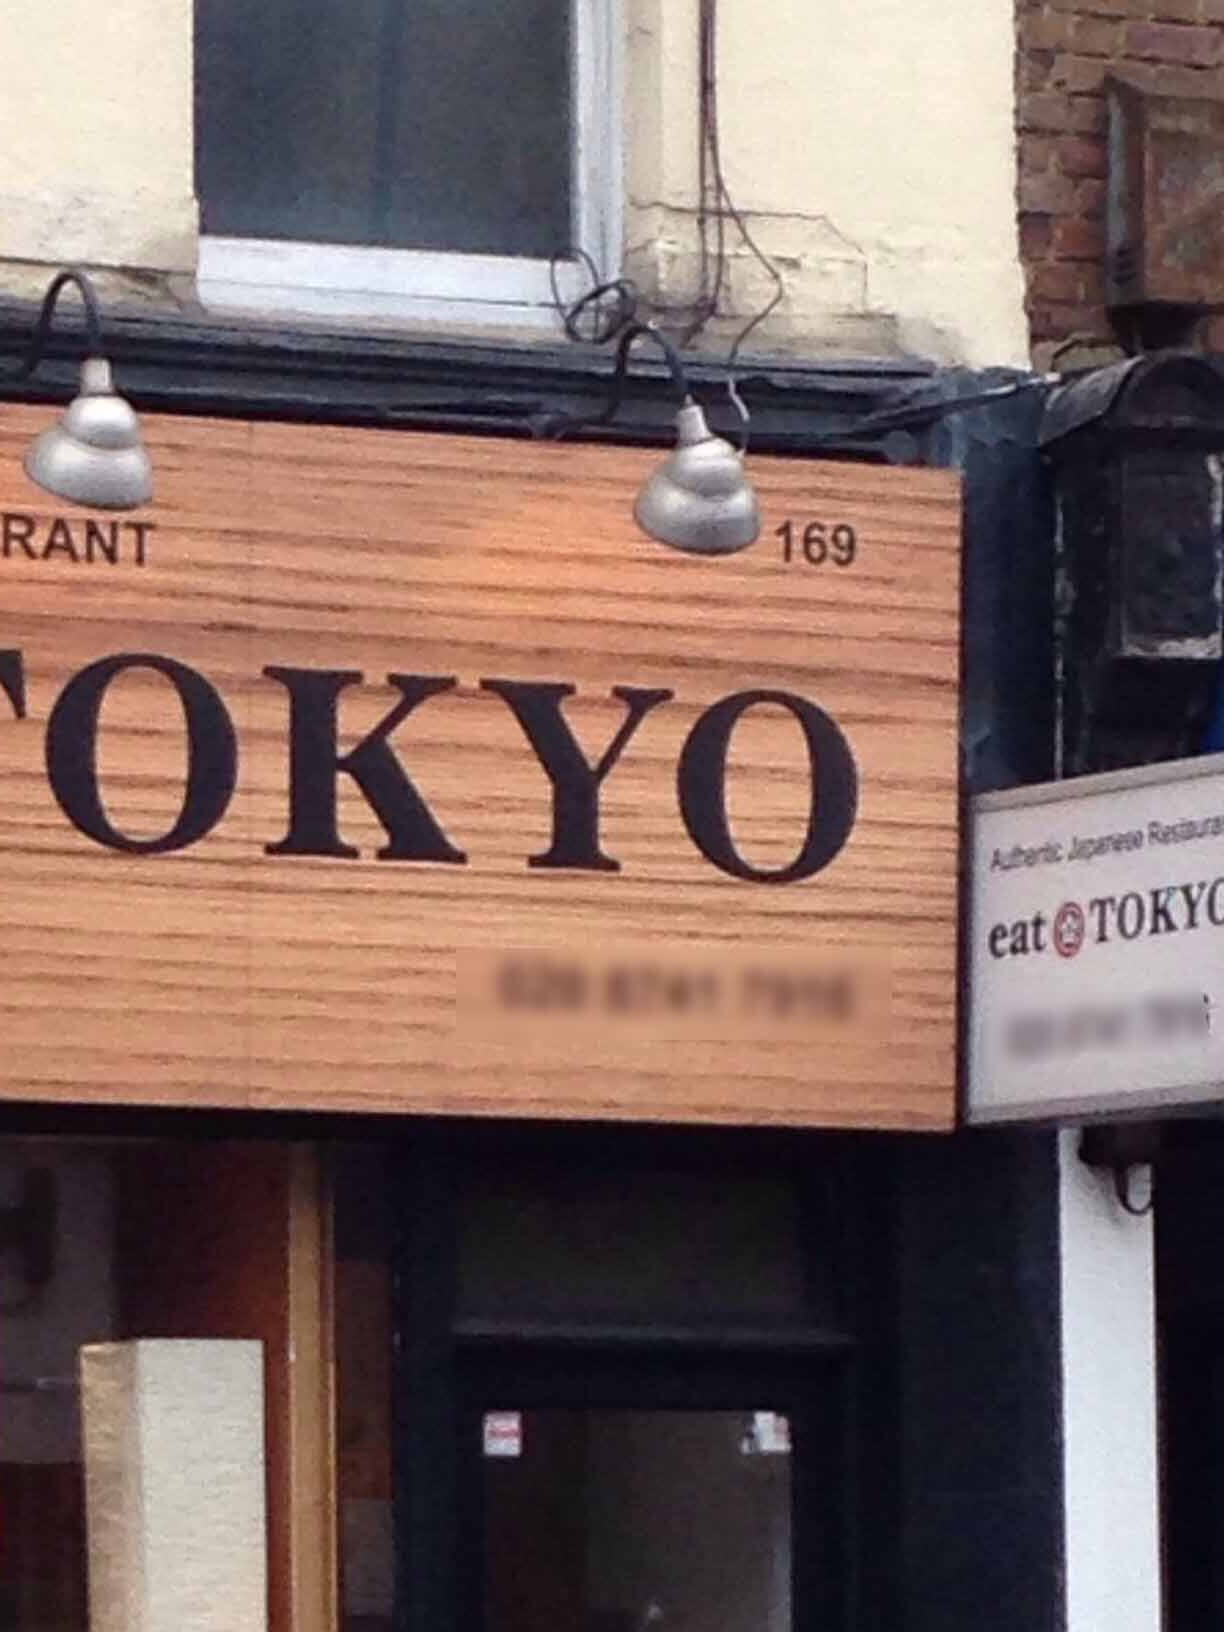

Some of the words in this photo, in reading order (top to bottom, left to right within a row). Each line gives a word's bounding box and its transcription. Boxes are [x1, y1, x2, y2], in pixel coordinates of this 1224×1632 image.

[774, 519, 857, 567] 169
[988, 911, 1046, 958] eat
[1090, 876, 1224, 943] TOKYO
